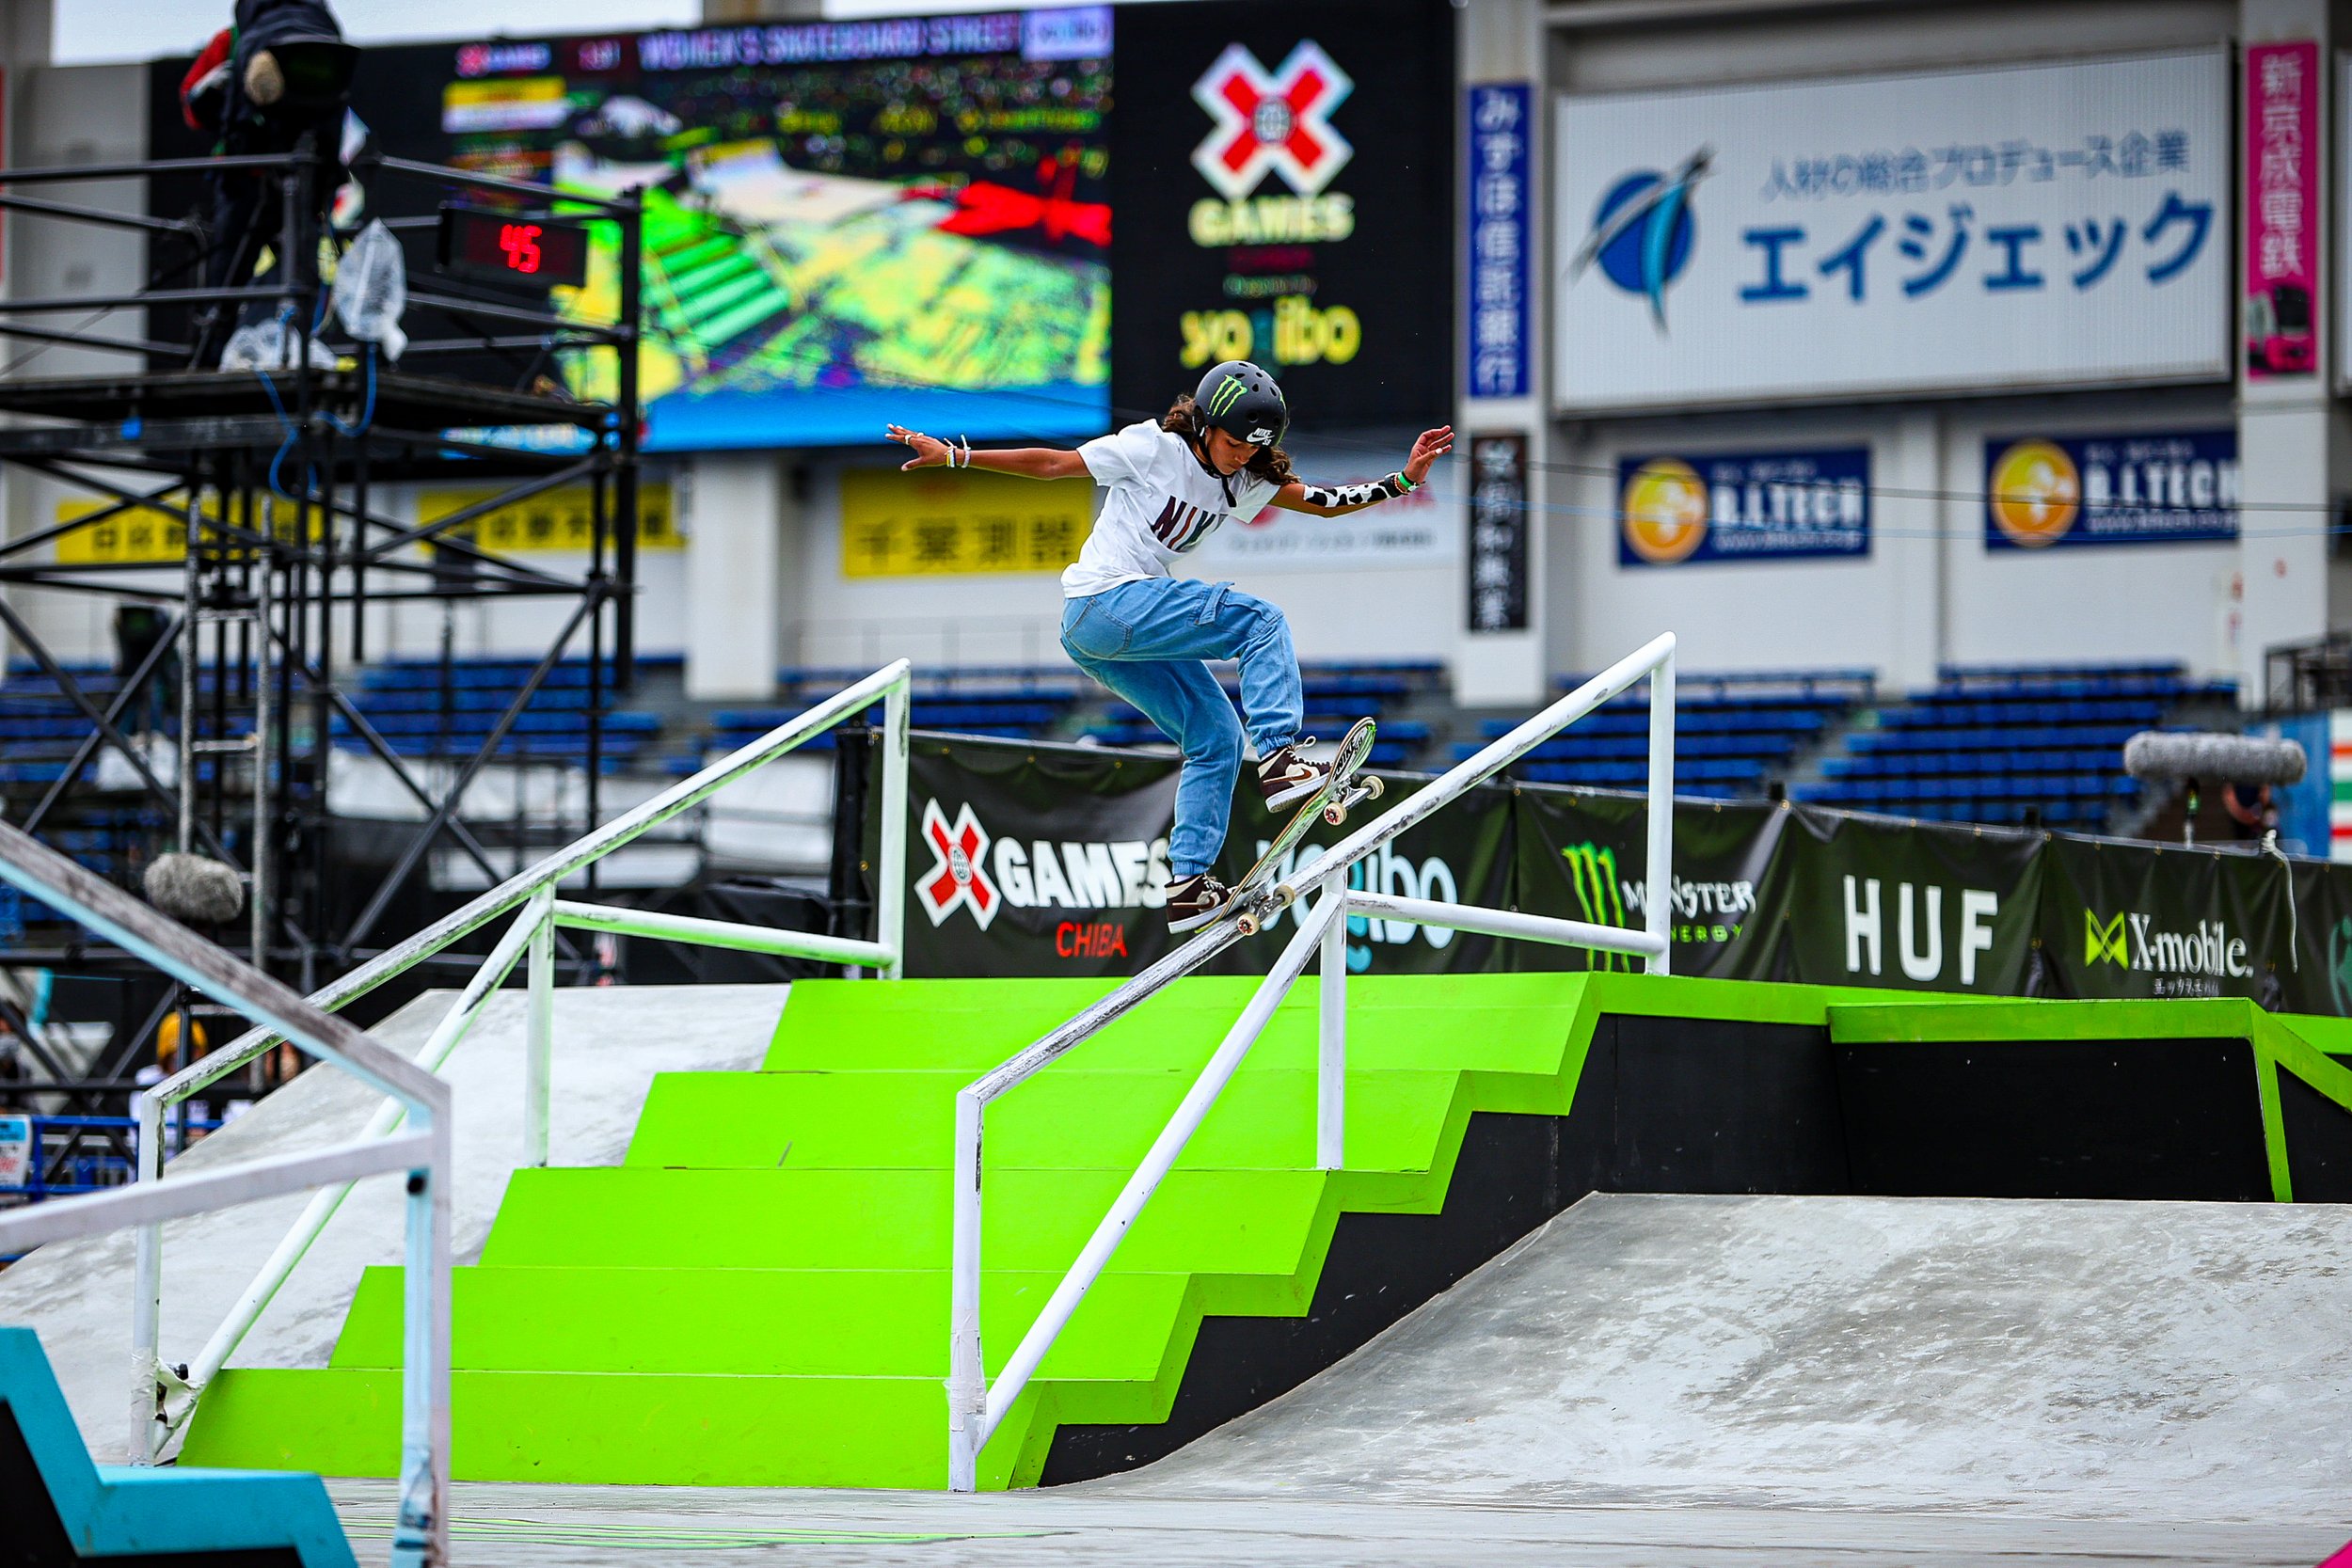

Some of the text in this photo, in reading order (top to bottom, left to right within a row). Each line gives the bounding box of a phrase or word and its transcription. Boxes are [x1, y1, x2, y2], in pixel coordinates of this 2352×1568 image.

[1759, 130, 2191, 202] 人材の総合プロデュース企業
[2259, 52, 2303, 279] 新京成電鉄
[500, 224, 542, 274] 45
[1187, 191, 1355, 248] GAMES
[1739, 191, 2215, 306] エイジェック
[1253, 427, 1273, 438] NIKE
[993, 836, 1172, 910] GAMES
[1621, 874, 1756, 920] MNSTER
[1055, 921, 1128, 958] CHIBA
[1843, 873, 1998, 986] HUF
